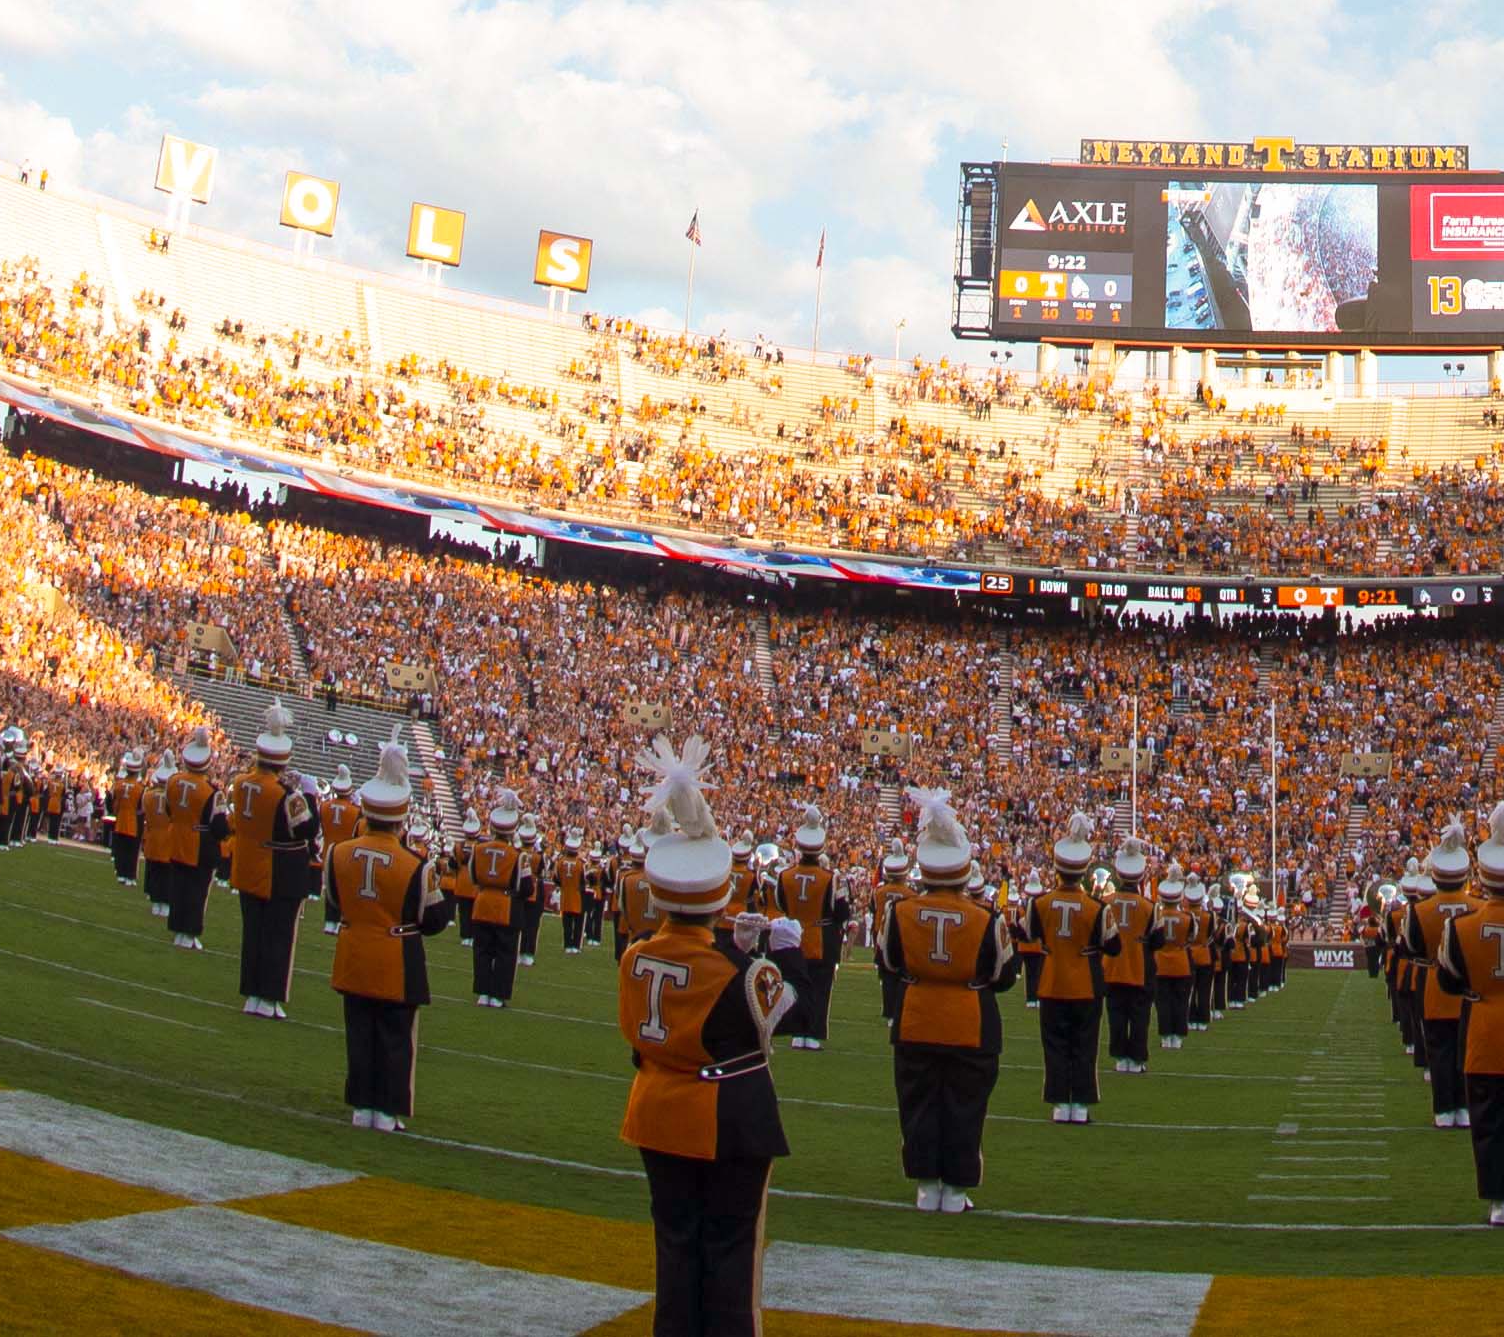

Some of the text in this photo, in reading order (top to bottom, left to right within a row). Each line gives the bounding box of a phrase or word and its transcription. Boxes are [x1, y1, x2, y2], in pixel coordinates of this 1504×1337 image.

[1093, 136, 1457, 171] NEYLAND T STADIUM
[1048, 201, 1127, 225] AXLE
[1442, 216, 1471, 226] Farm
[1049, 223, 1126, 233] LOGISTICS
[1048, 254, 1086, 270] 9:22
[1015, 274, 1064, 297] 0 T
[1104, 280, 1117, 296] 0
[1428, 276, 1462, 315] 13
[1013, 307, 1022, 318] 1
[1042, 307, 1059, 320] 10
[1112, 310, 1120, 323] 1
[986, 577, 1009, 590] 25
[1028, 579, 1068, 594] 1 DOWN
[1085, 583, 1127, 597] 10 TO GO
[1148, 585, 1201, 601] BALL ON 35
[1219, 588, 1244, 603] QTR 1
[1263, 594, 1271, 603] 3
[1293, 587, 1338, 605] 0 T
[1358, 589, 1398, 605] 9:21
[1451, 587, 1465, 602] 0
[1484, 593, 1492, 603] 3
[122, 782, 135, 799] T
[176, 779, 196, 808] T
[240, 782, 262, 818] T
[330, 804, 345, 824] T
[484, 848, 505, 877] T
[563, 860, 574, 877] T
[353, 846, 392, 899] T
[795, 873, 816, 902] T
[1051, 899, 1081, 938] T
[1116, 899, 1139, 928] T
[919, 908, 964, 964] T
[1163, 916, 1180, 940] T
[1314, 950, 1354, 962] WIVK
[632, 954, 690, 1043] T
